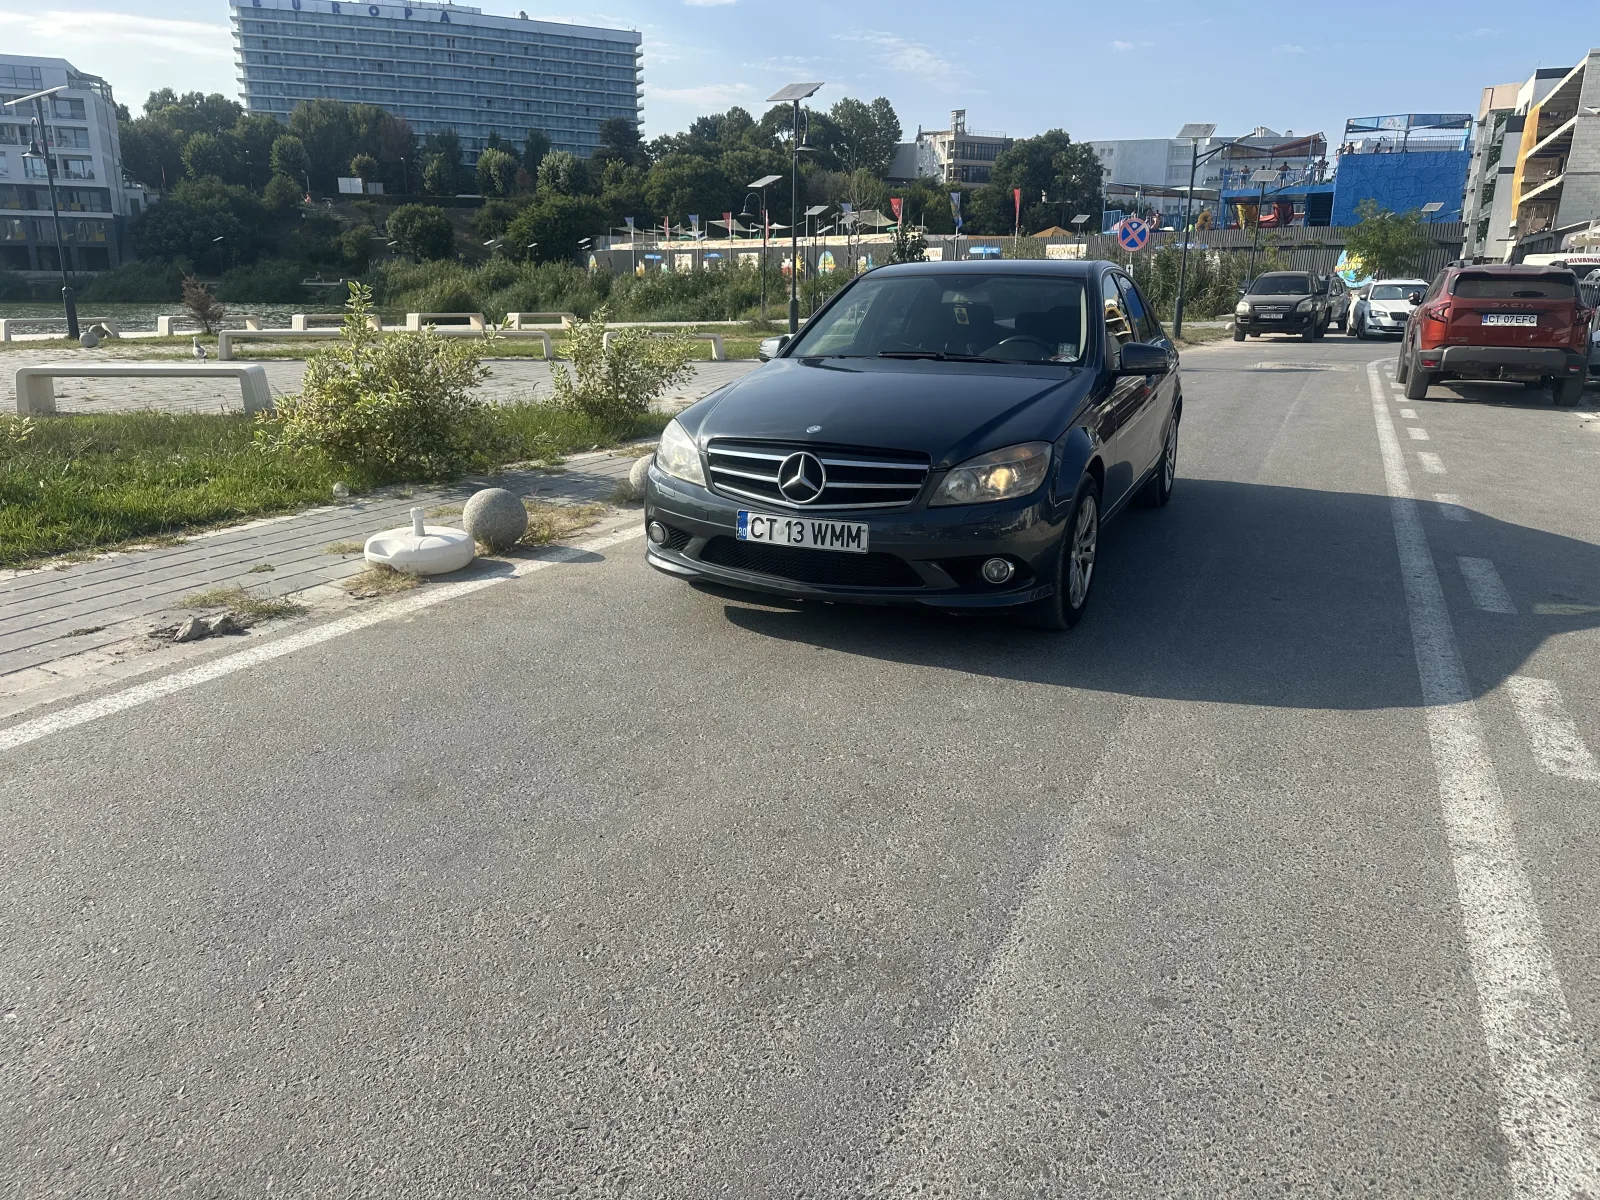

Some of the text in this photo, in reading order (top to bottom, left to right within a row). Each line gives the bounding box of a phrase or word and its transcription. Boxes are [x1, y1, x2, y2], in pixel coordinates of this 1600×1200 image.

[252, 0, 451, 22] EUROPA
[1488, 315, 1536, 324] CT 07EFC
[750, 516, 862, 549] CT 13 WMM
